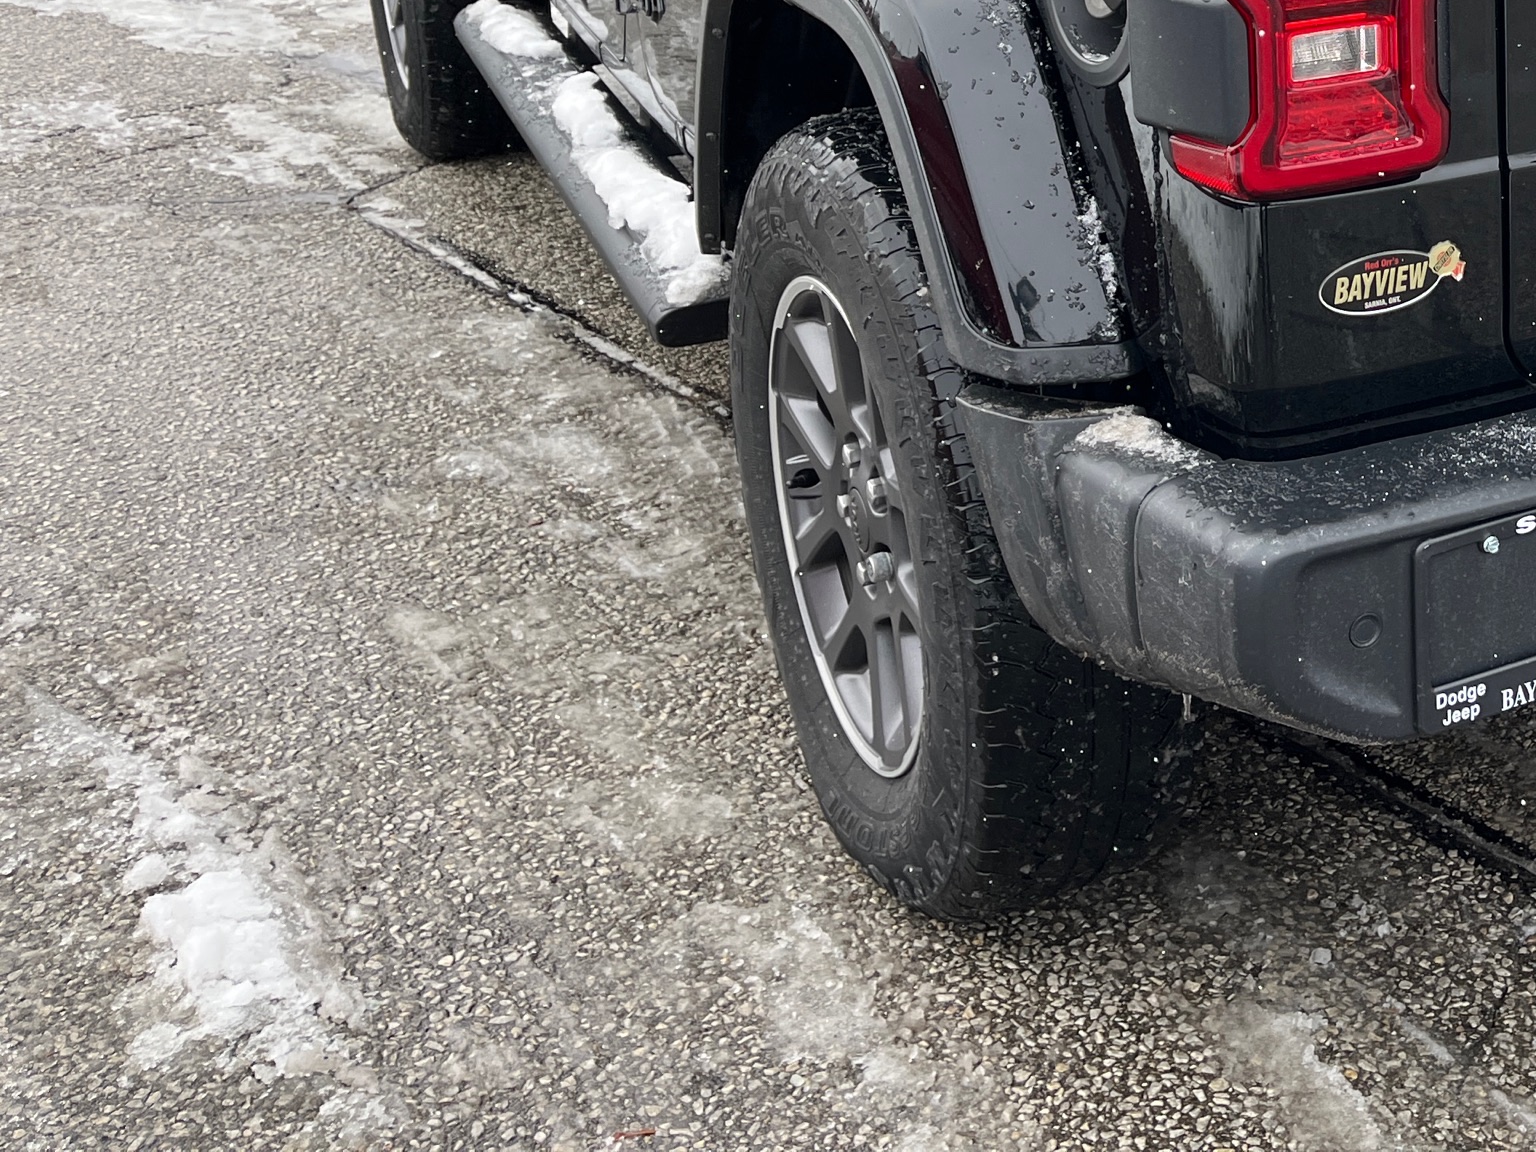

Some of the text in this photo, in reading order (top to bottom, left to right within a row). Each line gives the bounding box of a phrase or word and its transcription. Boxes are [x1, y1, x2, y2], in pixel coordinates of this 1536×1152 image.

[1364, 257, 1399, 270] Red Orr's
[1334, 261, 1428, 304] BAYVIEW
[1435, 682, 1487, 710] Dodge
[1442, 702, 1481, 726] Jeep
